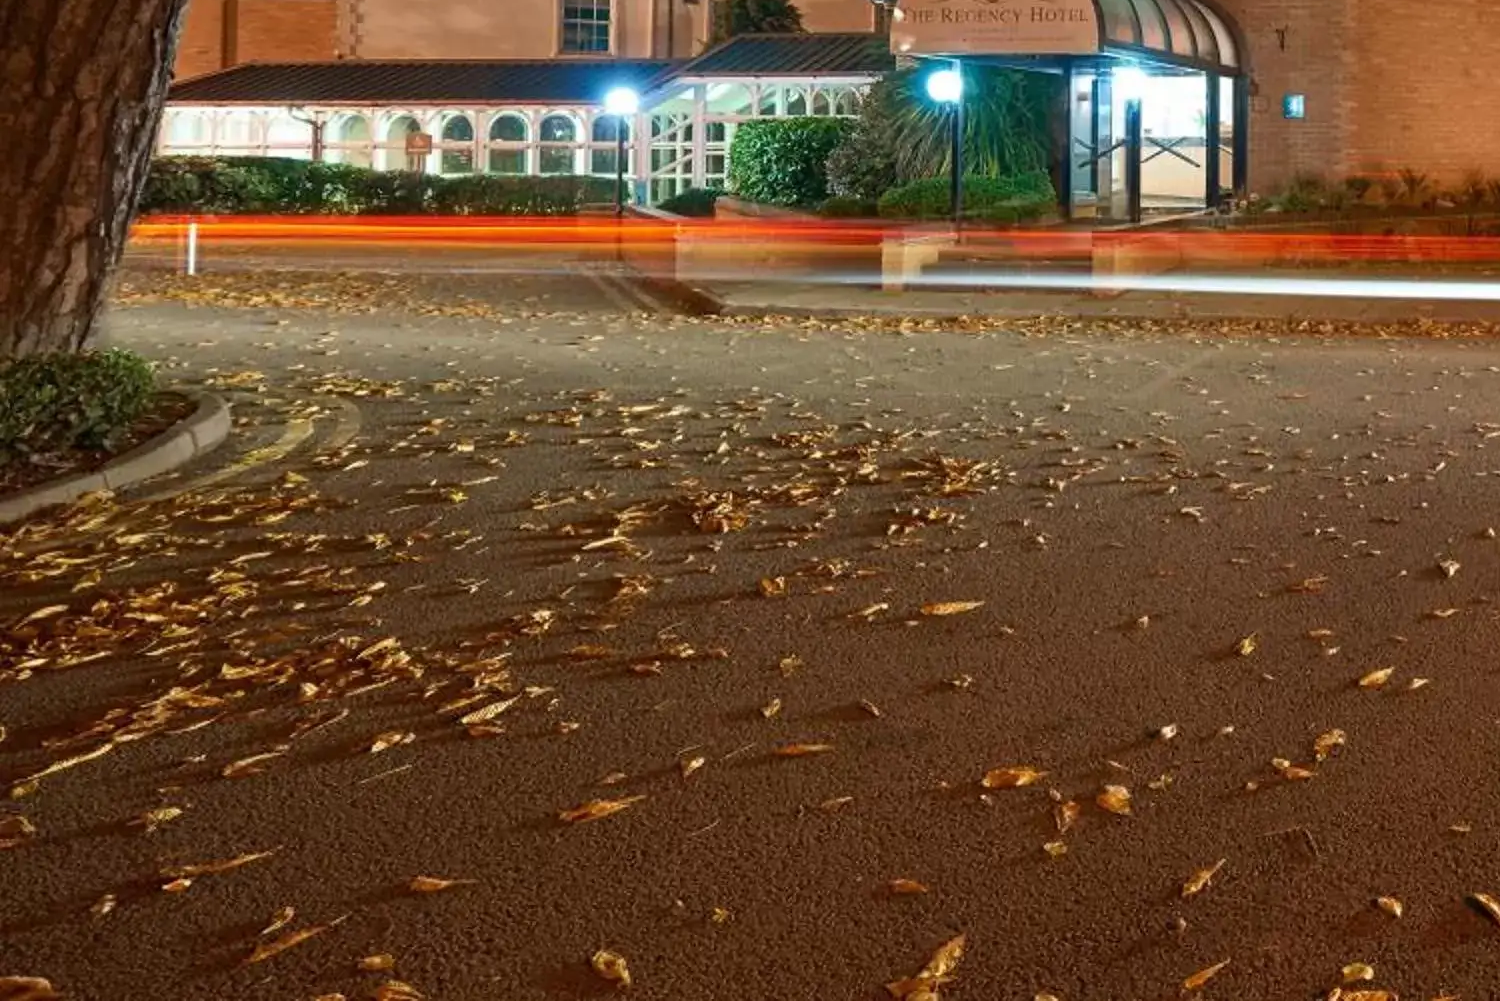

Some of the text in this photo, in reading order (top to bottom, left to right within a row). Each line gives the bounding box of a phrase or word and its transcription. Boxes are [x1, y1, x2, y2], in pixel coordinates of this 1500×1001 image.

[903, 5, 1089, 24] THE REGENCY HOTEL
